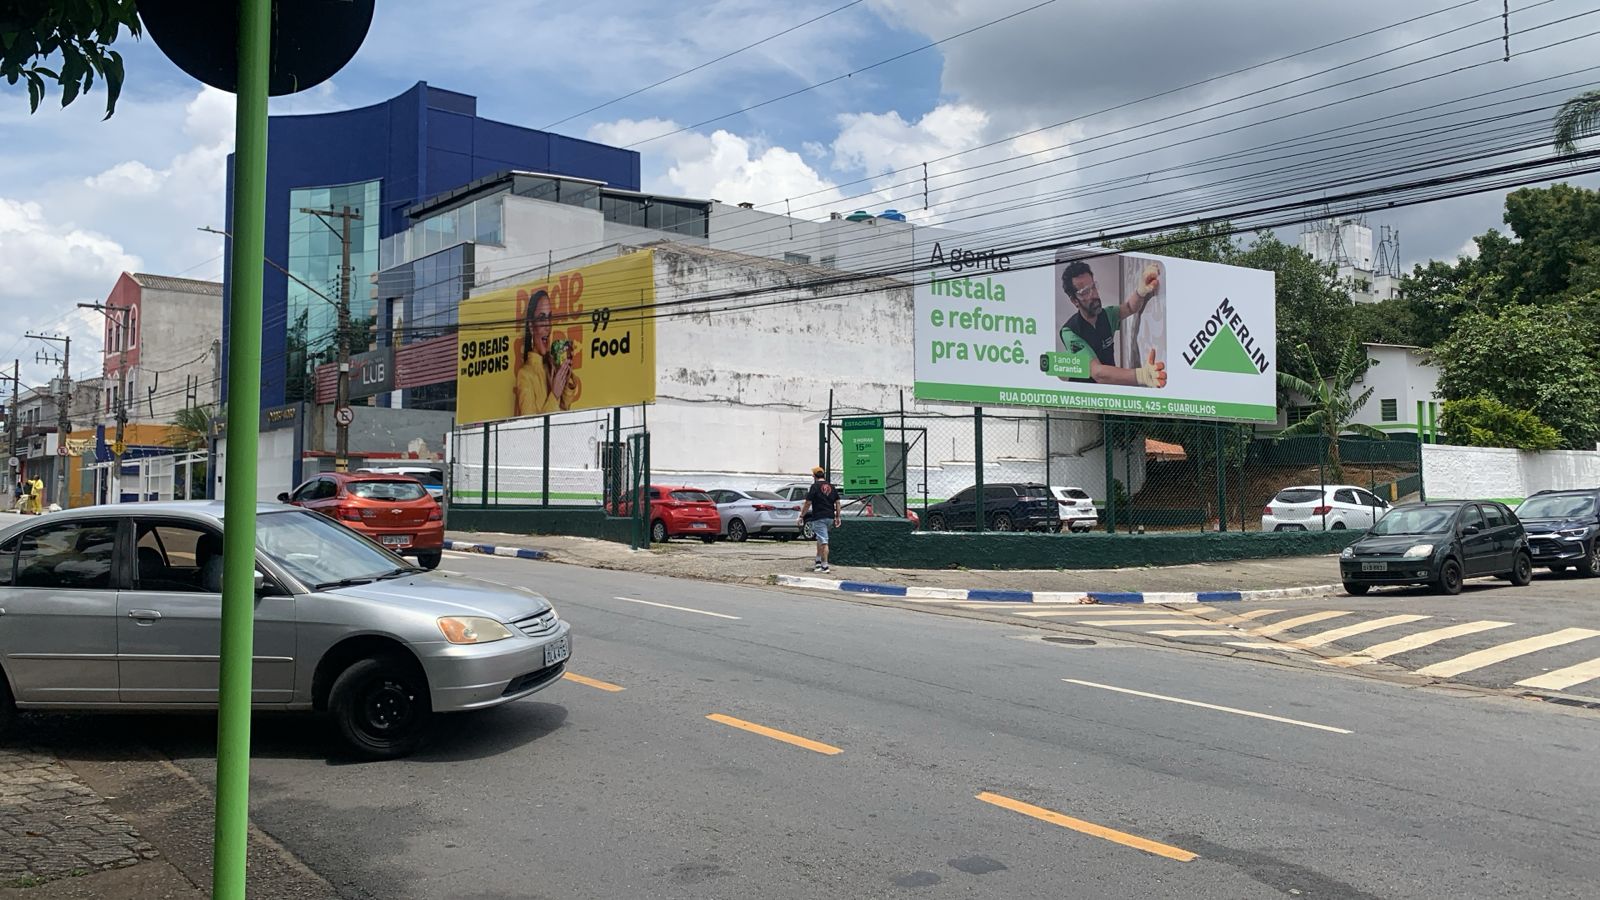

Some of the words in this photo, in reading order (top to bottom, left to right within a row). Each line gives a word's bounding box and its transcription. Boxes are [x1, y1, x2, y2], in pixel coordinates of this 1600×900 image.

[930, 242, 945, 264] A
[950, 248, 1011, 272] gente
[930, 272, 1006, 301] instala
[592, 307, 610, 333] 99
[930, 309, 944, 327] e
[949, 306, 1037, 335] reforma
[461, 341, 477, 361] 99
[479, 335, 509, 358] REAIS
[591, 331, 630, 359] Food
[1182, 308, 1224, 366] LEROY
[1219, 297, 1270, 374] MERLIN
[931, 340, 968, 364] pra
[973, 339, 1029, 364] você.
[1057, 356, 1071, 364] ano
[1072, 357, 1081, 365] de
[468, 355, 509, 377] CUPONS
[1053, 364, 1082, 374] Garantia
[1000, 391, 1019, 402] RUA
[1020, 392, 1058, 404] DOUTOR
[1060, 395, 1121, 408] WASHINGTON
[1123, 399, 1144, 411] LUIS,
[1145, 401, 1161, 411] 425
[1167, 402, 1217, 415] GUARULHOS
